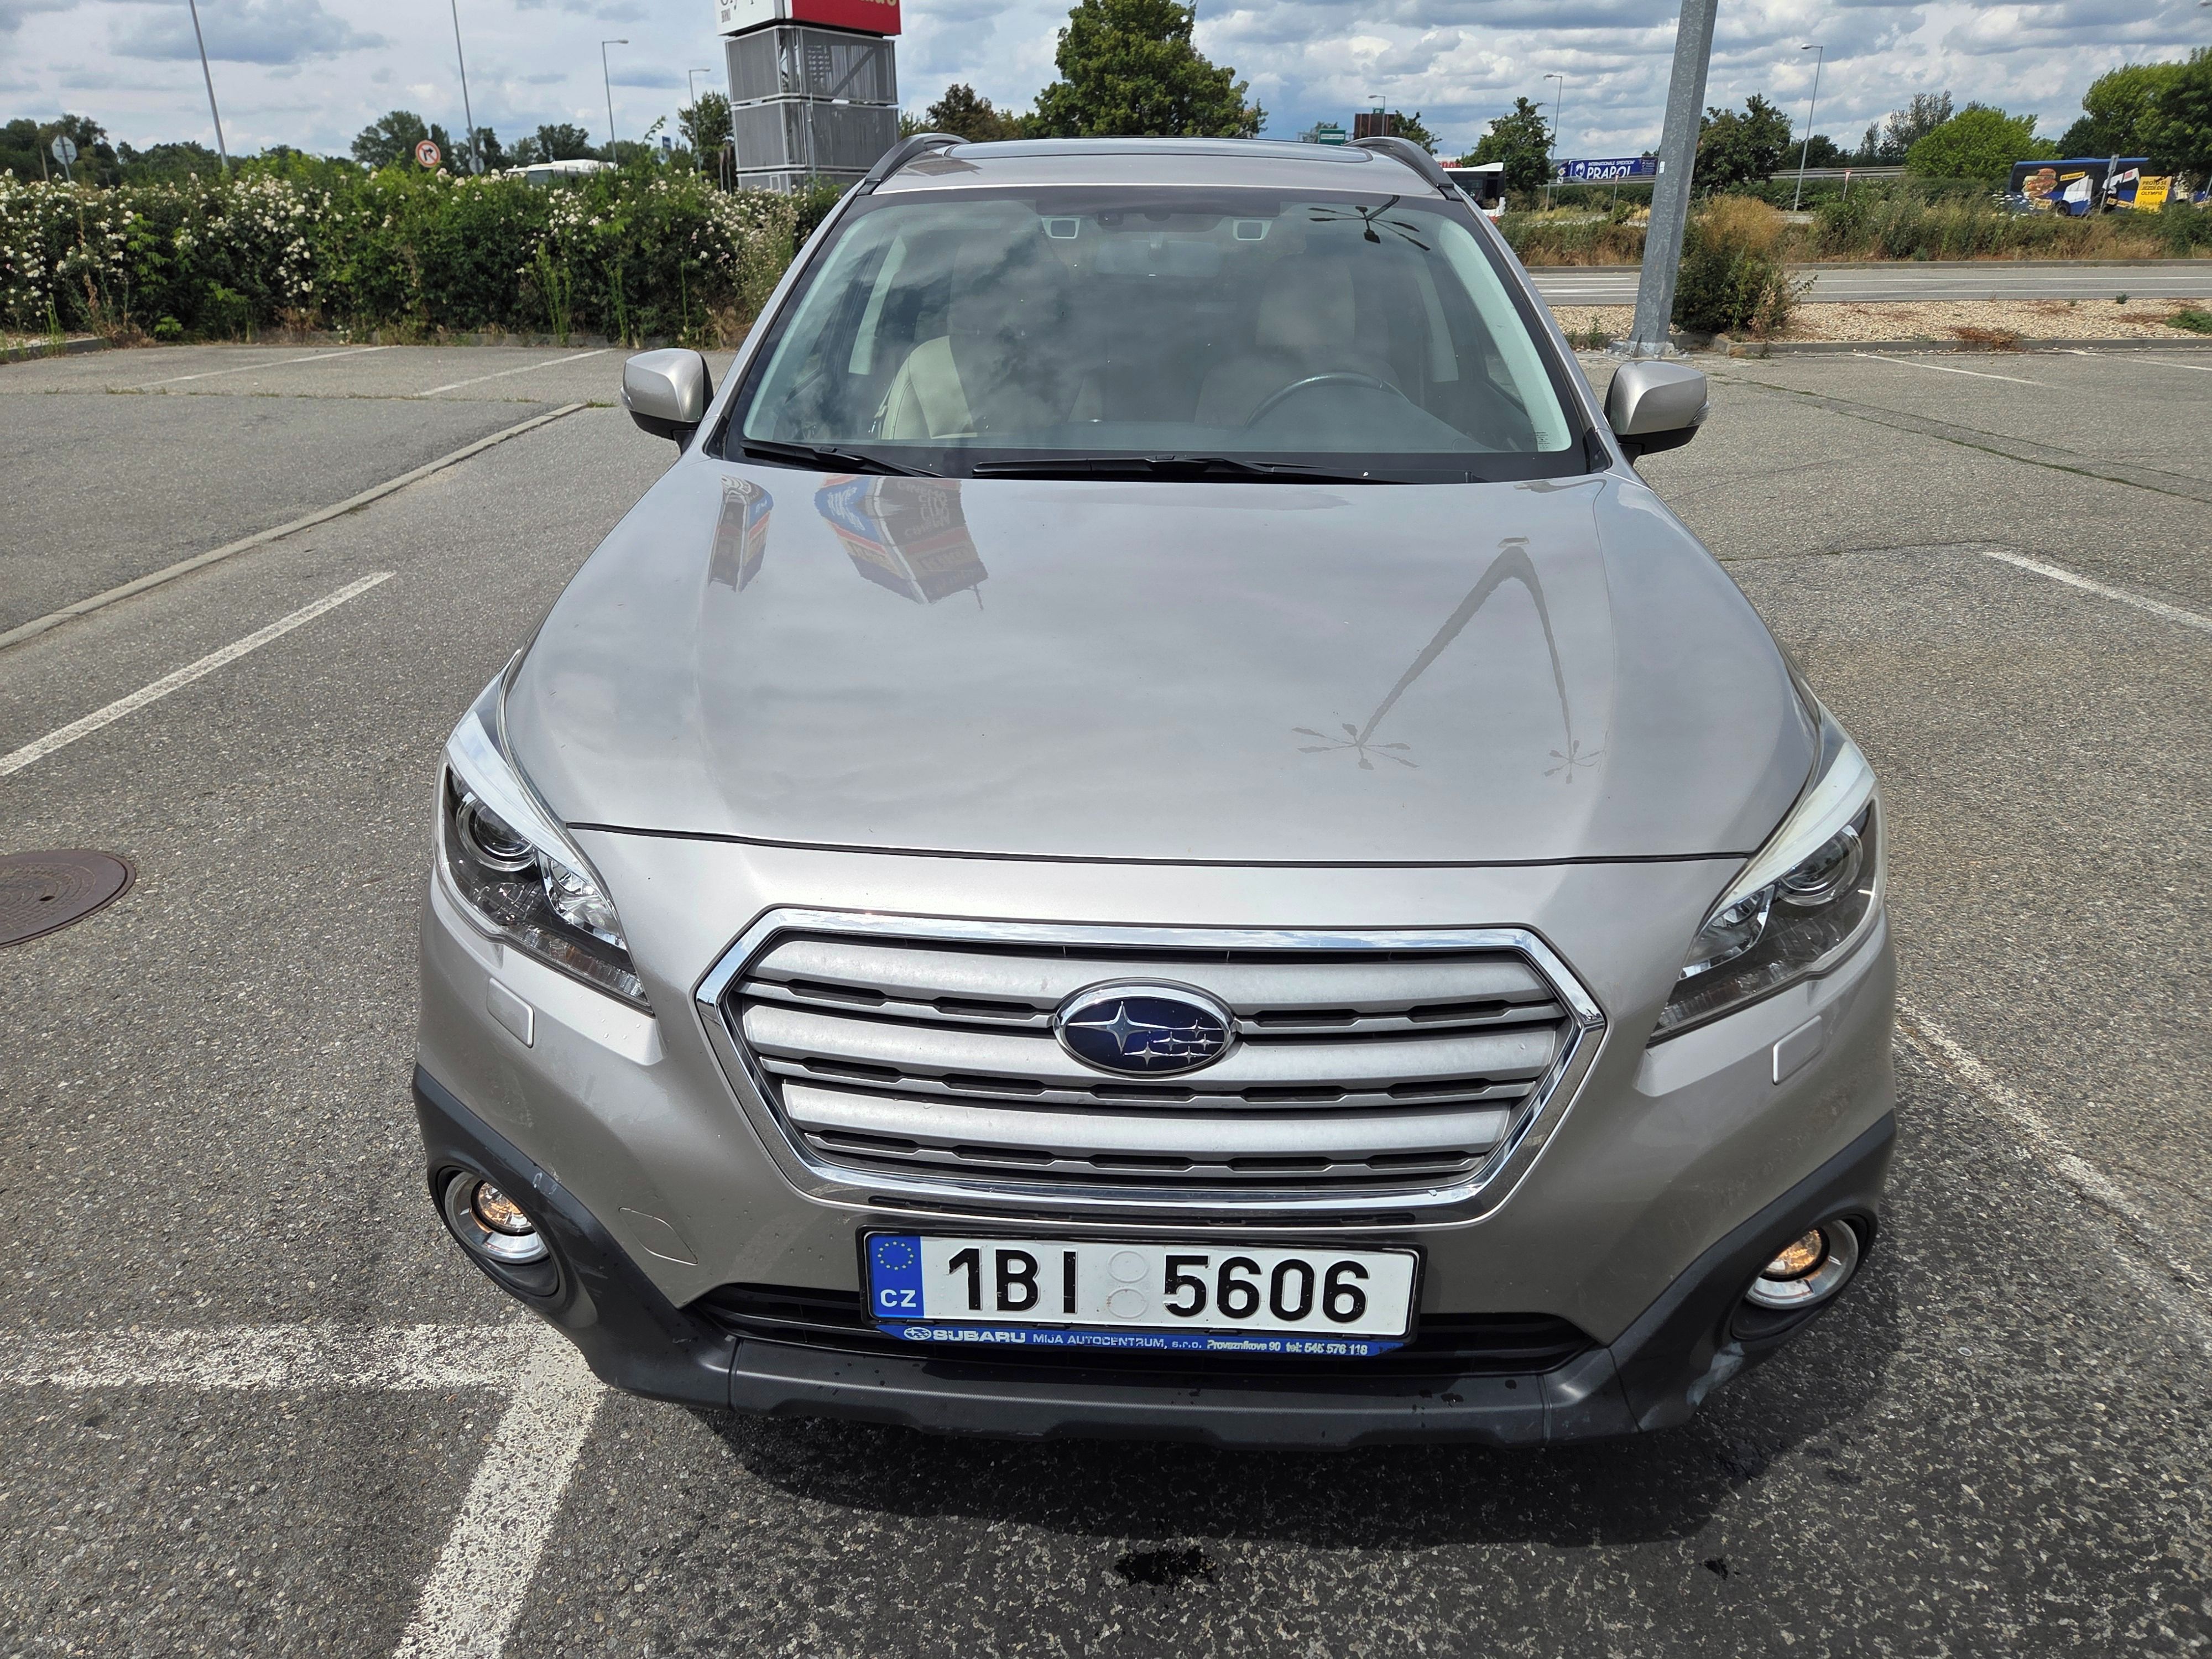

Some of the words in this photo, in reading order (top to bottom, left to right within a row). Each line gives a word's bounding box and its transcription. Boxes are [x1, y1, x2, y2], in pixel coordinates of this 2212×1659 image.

[948, 1248, 1076, 1313] 1BI
[1164, 1255, 1370, 1323] 5606
[880, 1290, 916, 1307] CZ
[933, 1330, 1026, 1343] SUBARU
[1172, 1340, 1202, 1349] s.r.o.
[1269, 1342, 1281, 1351] 90
[1326, 1344, 1347, 1354] 576
[1349, 1344, 1368, 1355] 118
